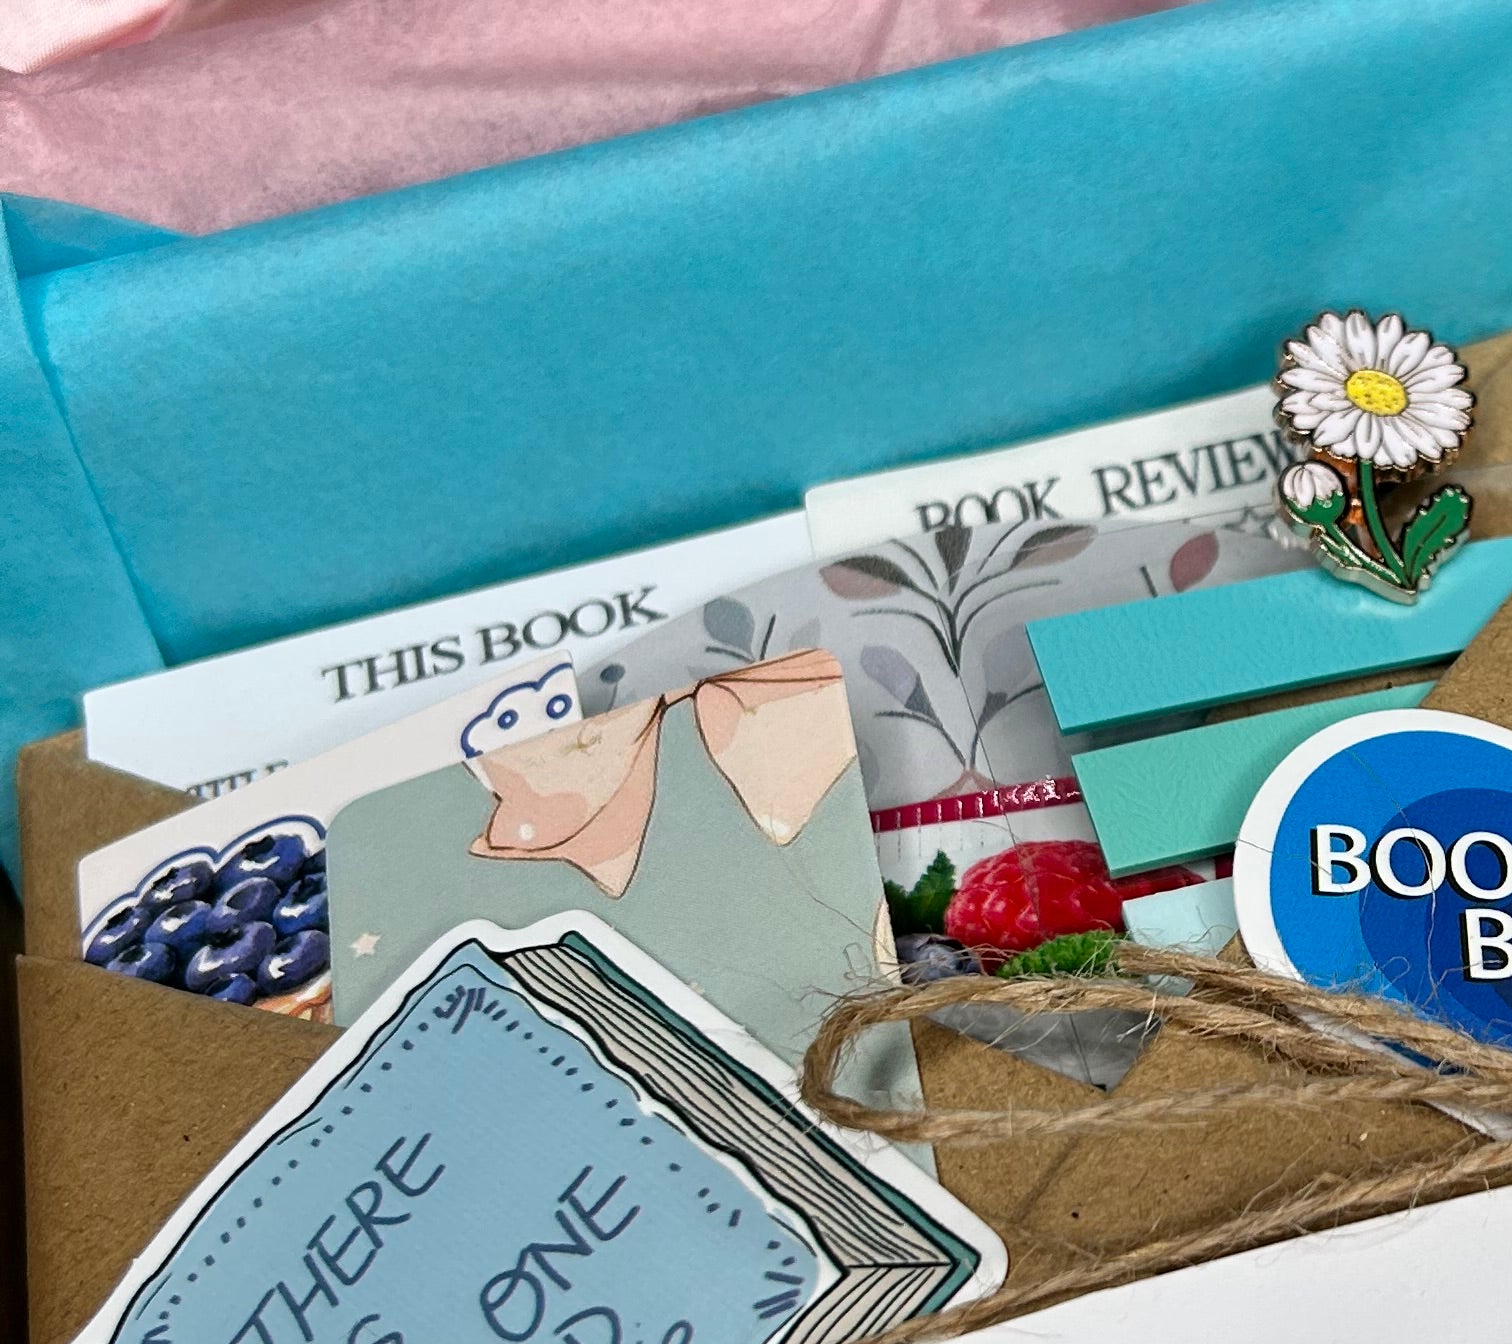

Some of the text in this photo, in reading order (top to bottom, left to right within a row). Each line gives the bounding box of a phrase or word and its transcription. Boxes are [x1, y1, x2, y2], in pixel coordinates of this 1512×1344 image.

[916, 476, 1065, 533] BOOK
[321, 584, 669, 705] THIS BOOK
[479, 1164, 641, 1342] ONE
